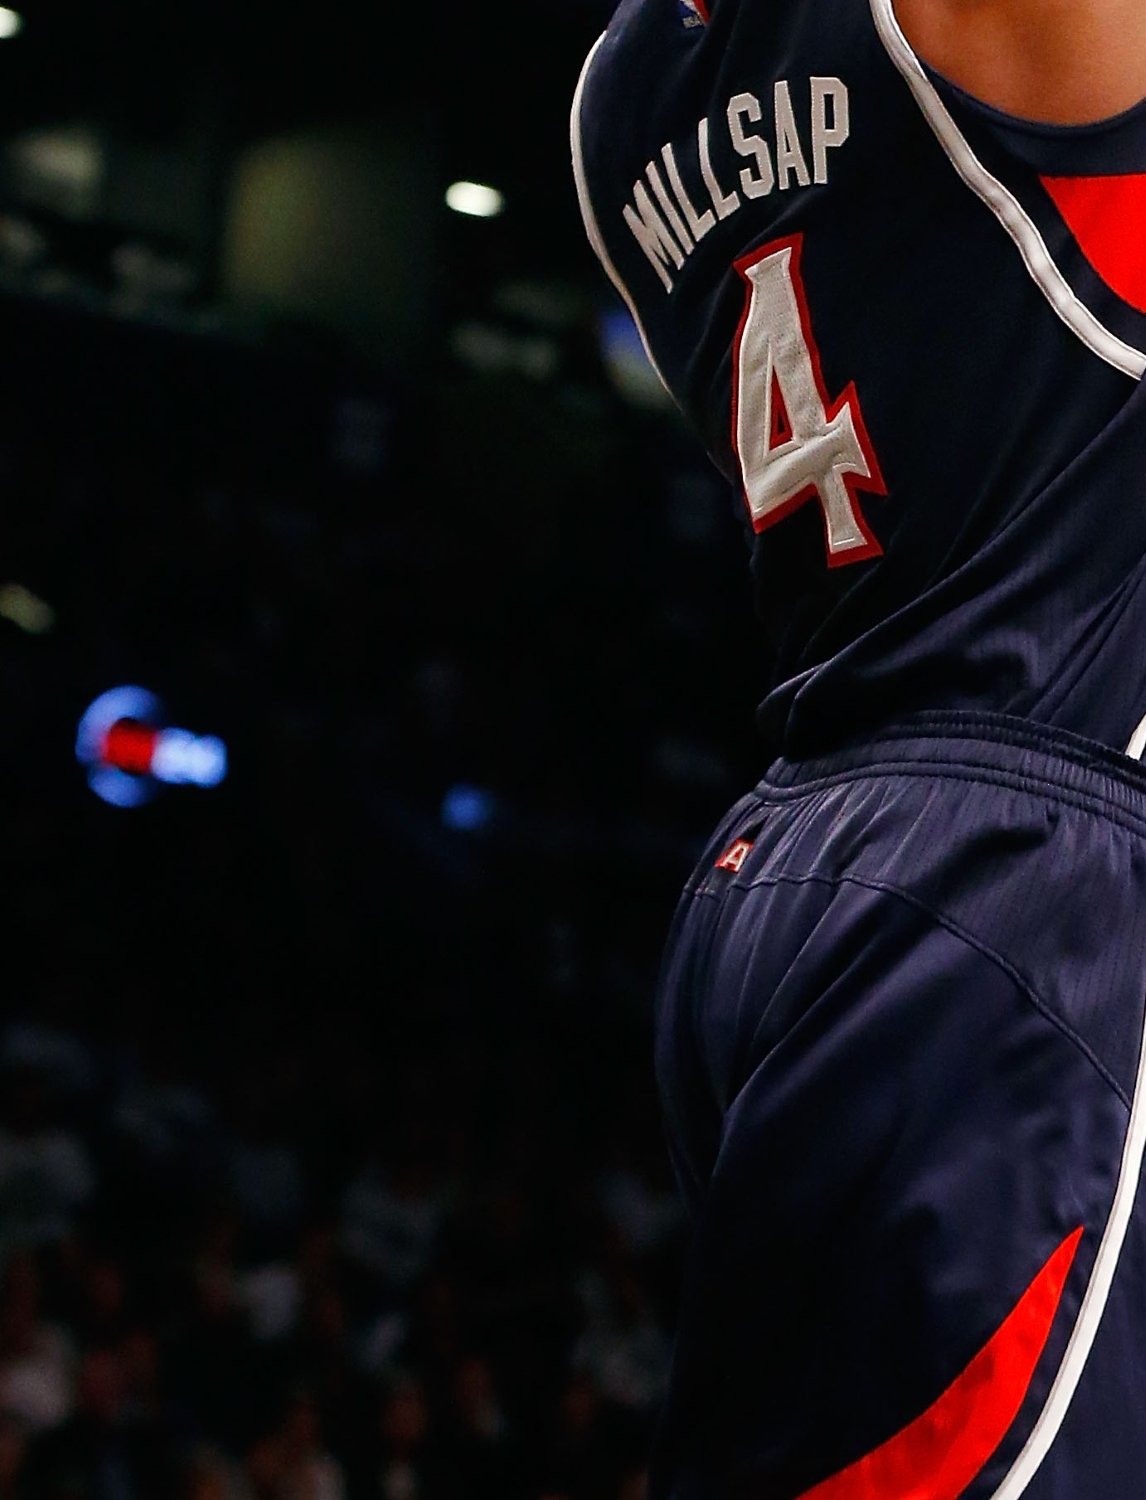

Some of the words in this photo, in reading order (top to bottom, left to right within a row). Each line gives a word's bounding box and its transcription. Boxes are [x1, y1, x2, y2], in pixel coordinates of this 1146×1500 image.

[622, 76, 850, 294] MILLSAP
[733, 233, 888, 568] 4
[715, 838, 754, 873] A
